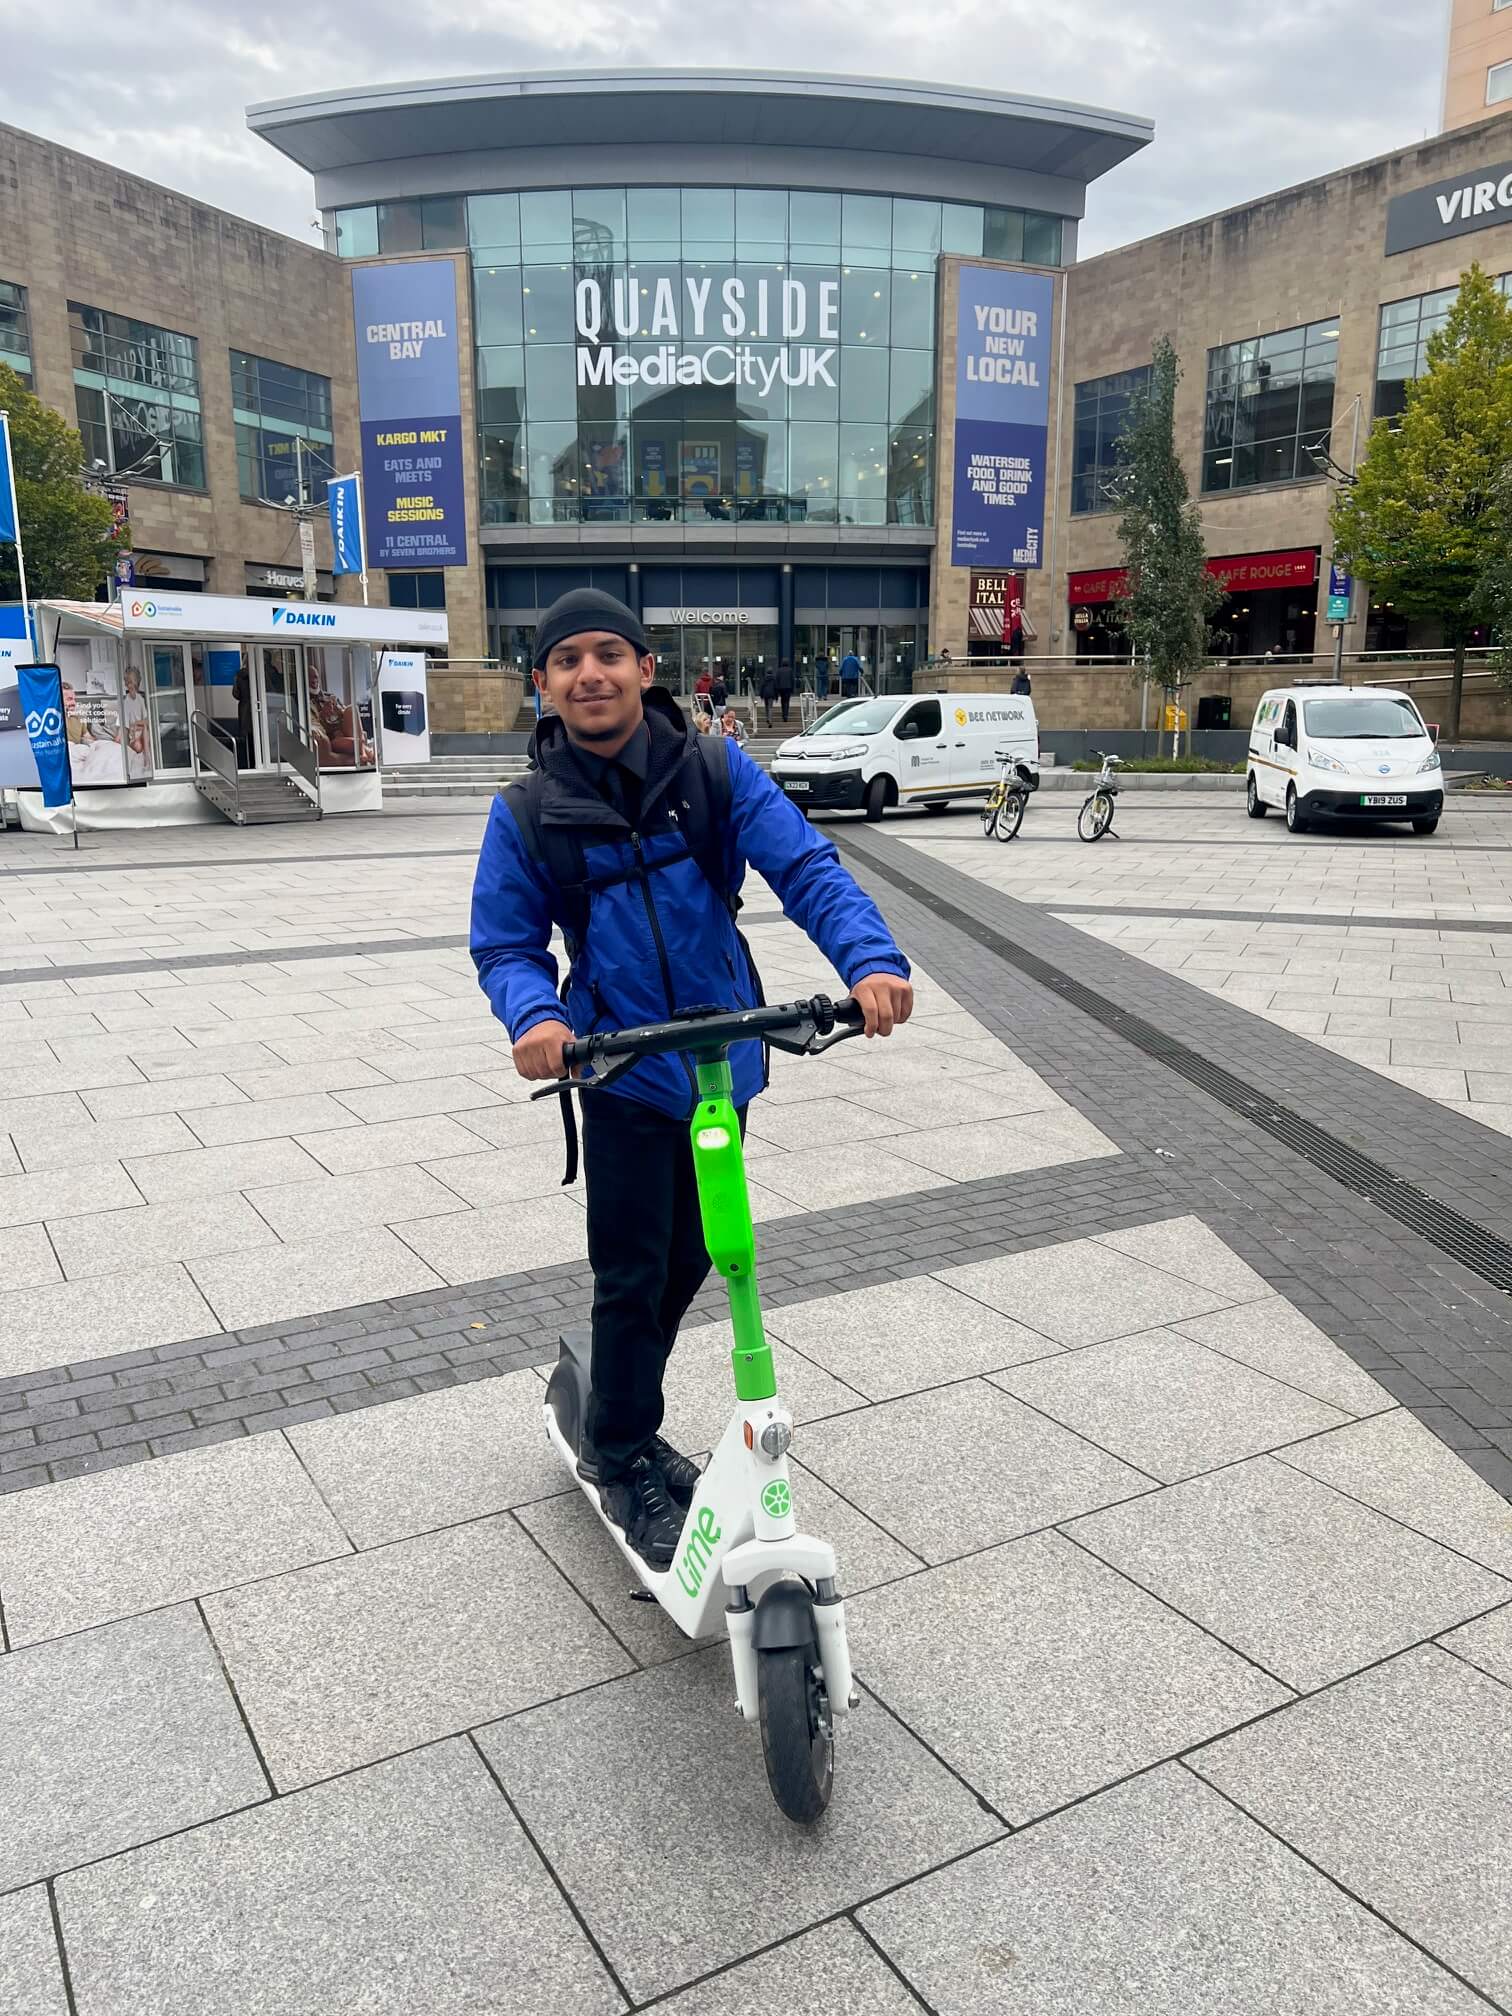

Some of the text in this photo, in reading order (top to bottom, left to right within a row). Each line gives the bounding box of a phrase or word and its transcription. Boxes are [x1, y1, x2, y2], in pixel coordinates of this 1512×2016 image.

[575, 278, 839, 345] QUAYSIDE
[974, 305, 1037, 336] YOUR
[366, 320, 446, 343] CENTRAL
[390, 340, 423, 360] BAY
[985, 336, 1024, 356] NEW
[576, 345, 837, 397] MediaCityUK
[967, 355, 1040, 387] LOCAL
[376, 430, 447, 446] KARGO MKT
[384, 457, 442, 471] EATS AND
[971, 454, 1031, 470] WATERSIDE
[395, 471, 432, 483] MEETS
[967, 466, 1032, 482] FOOD, DRINK
[972, 480, 1028, 494] AND GOOD
[396, 496, 433, 509] MUSIC
[982, 493, 1017, 506] TIMES.
[336, 487, 345, 552] DAIKIN
[387, 508, 444, 522] SESSIONS
[385, 534, 448, 548] 11 CENTRAL
[1026, 527, 1038, 549] CITY
[392, 548, 415, 557] SEVEN
[1013, 549, 1037, 564] MEDIA
[1250, 563, 1292, 579] ROUGE
[266, 570, 304, 588] Harves
[978, 579, 1007, 591] BELL
[976, 592, 1004, 604] ITAL
[286, 612, 336, 626] DAIKIN
[671, 608, 749, 623] Welcome
[968, 710, 1025, 722] BEE NETWORK
